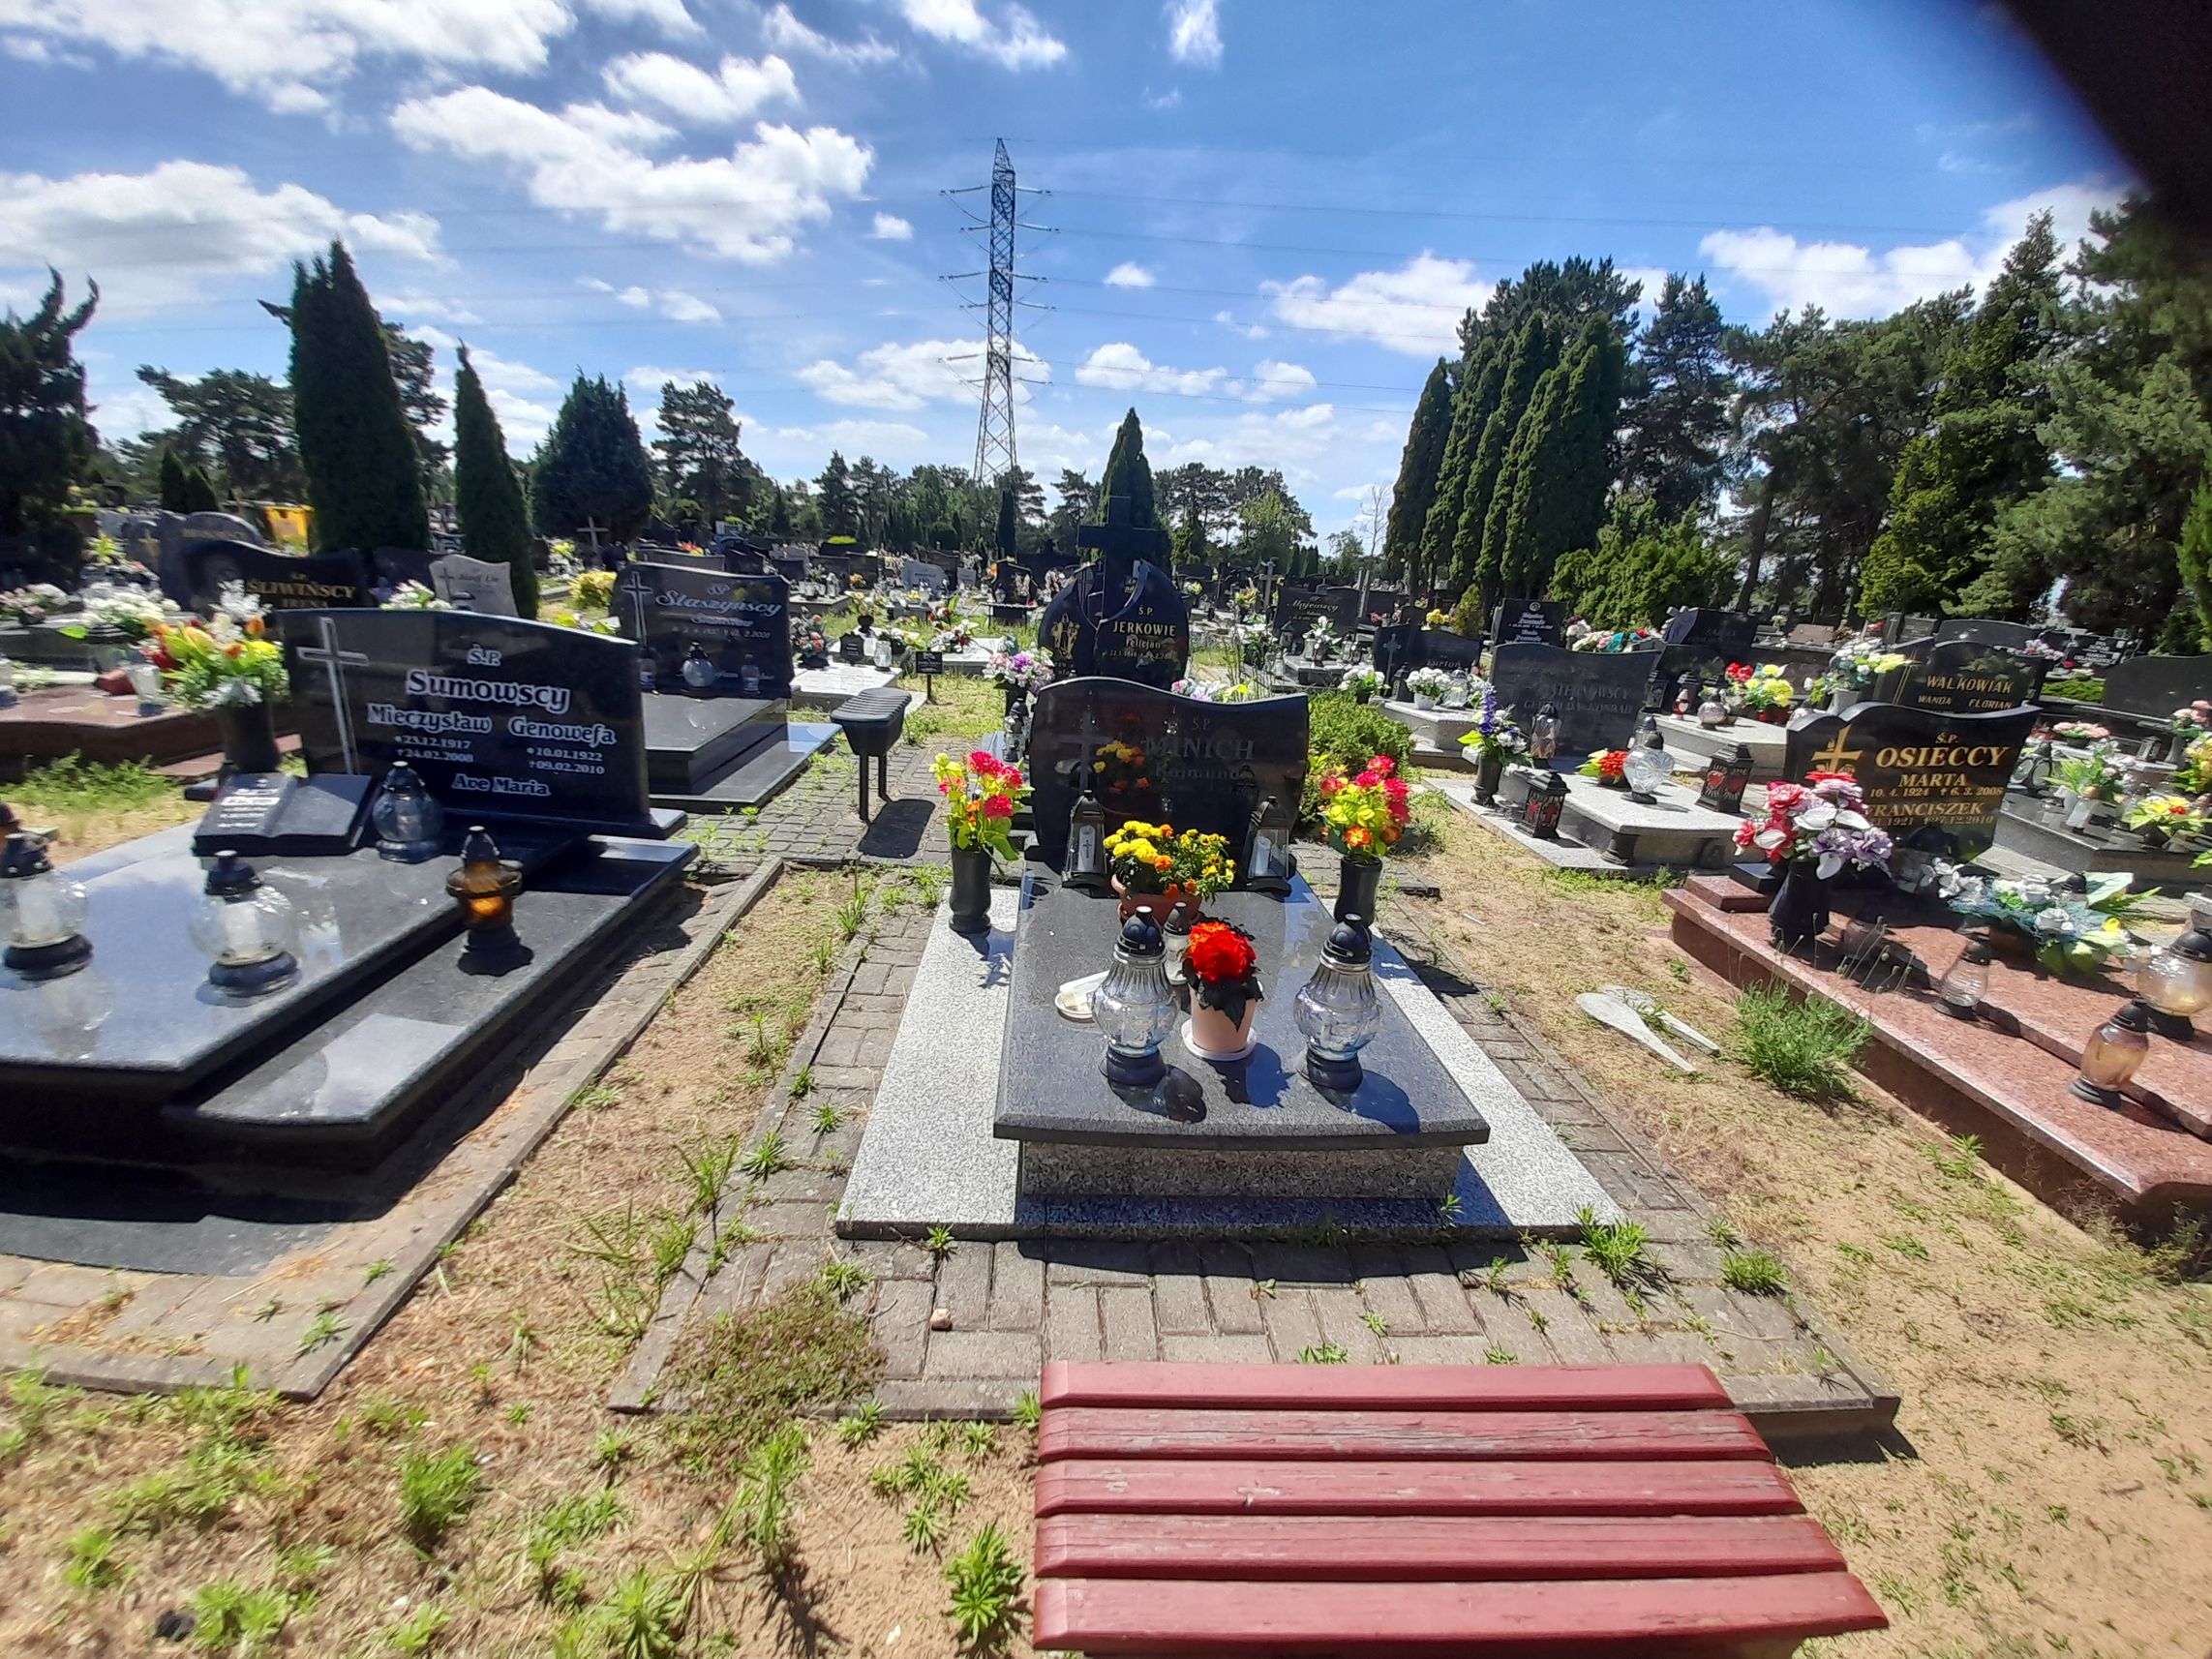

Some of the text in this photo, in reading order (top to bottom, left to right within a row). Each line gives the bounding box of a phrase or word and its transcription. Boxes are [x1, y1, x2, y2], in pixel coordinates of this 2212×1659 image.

[1113, 620, 1177, 636] JERKOWIE
[467, 644, 502, 666] Ś.P.
[407, 669, 571, 714] Sumowscy
[1926, 675, 2015, 694] WALKOWIAK
[1918, 695, 2012, 709] WANDA FLORIAN
[367, 703, 617, 748] Mieczysław Genowefa
[1935, 732, 1959, 743] Ś.P.
[1875, 746, 2011, 768] OSIECCY
[452, 773, 552, 797] Ave Maria
[1897, 773, 1967, 788] MARTA
[1902, 787, 1928, 797] 1924
